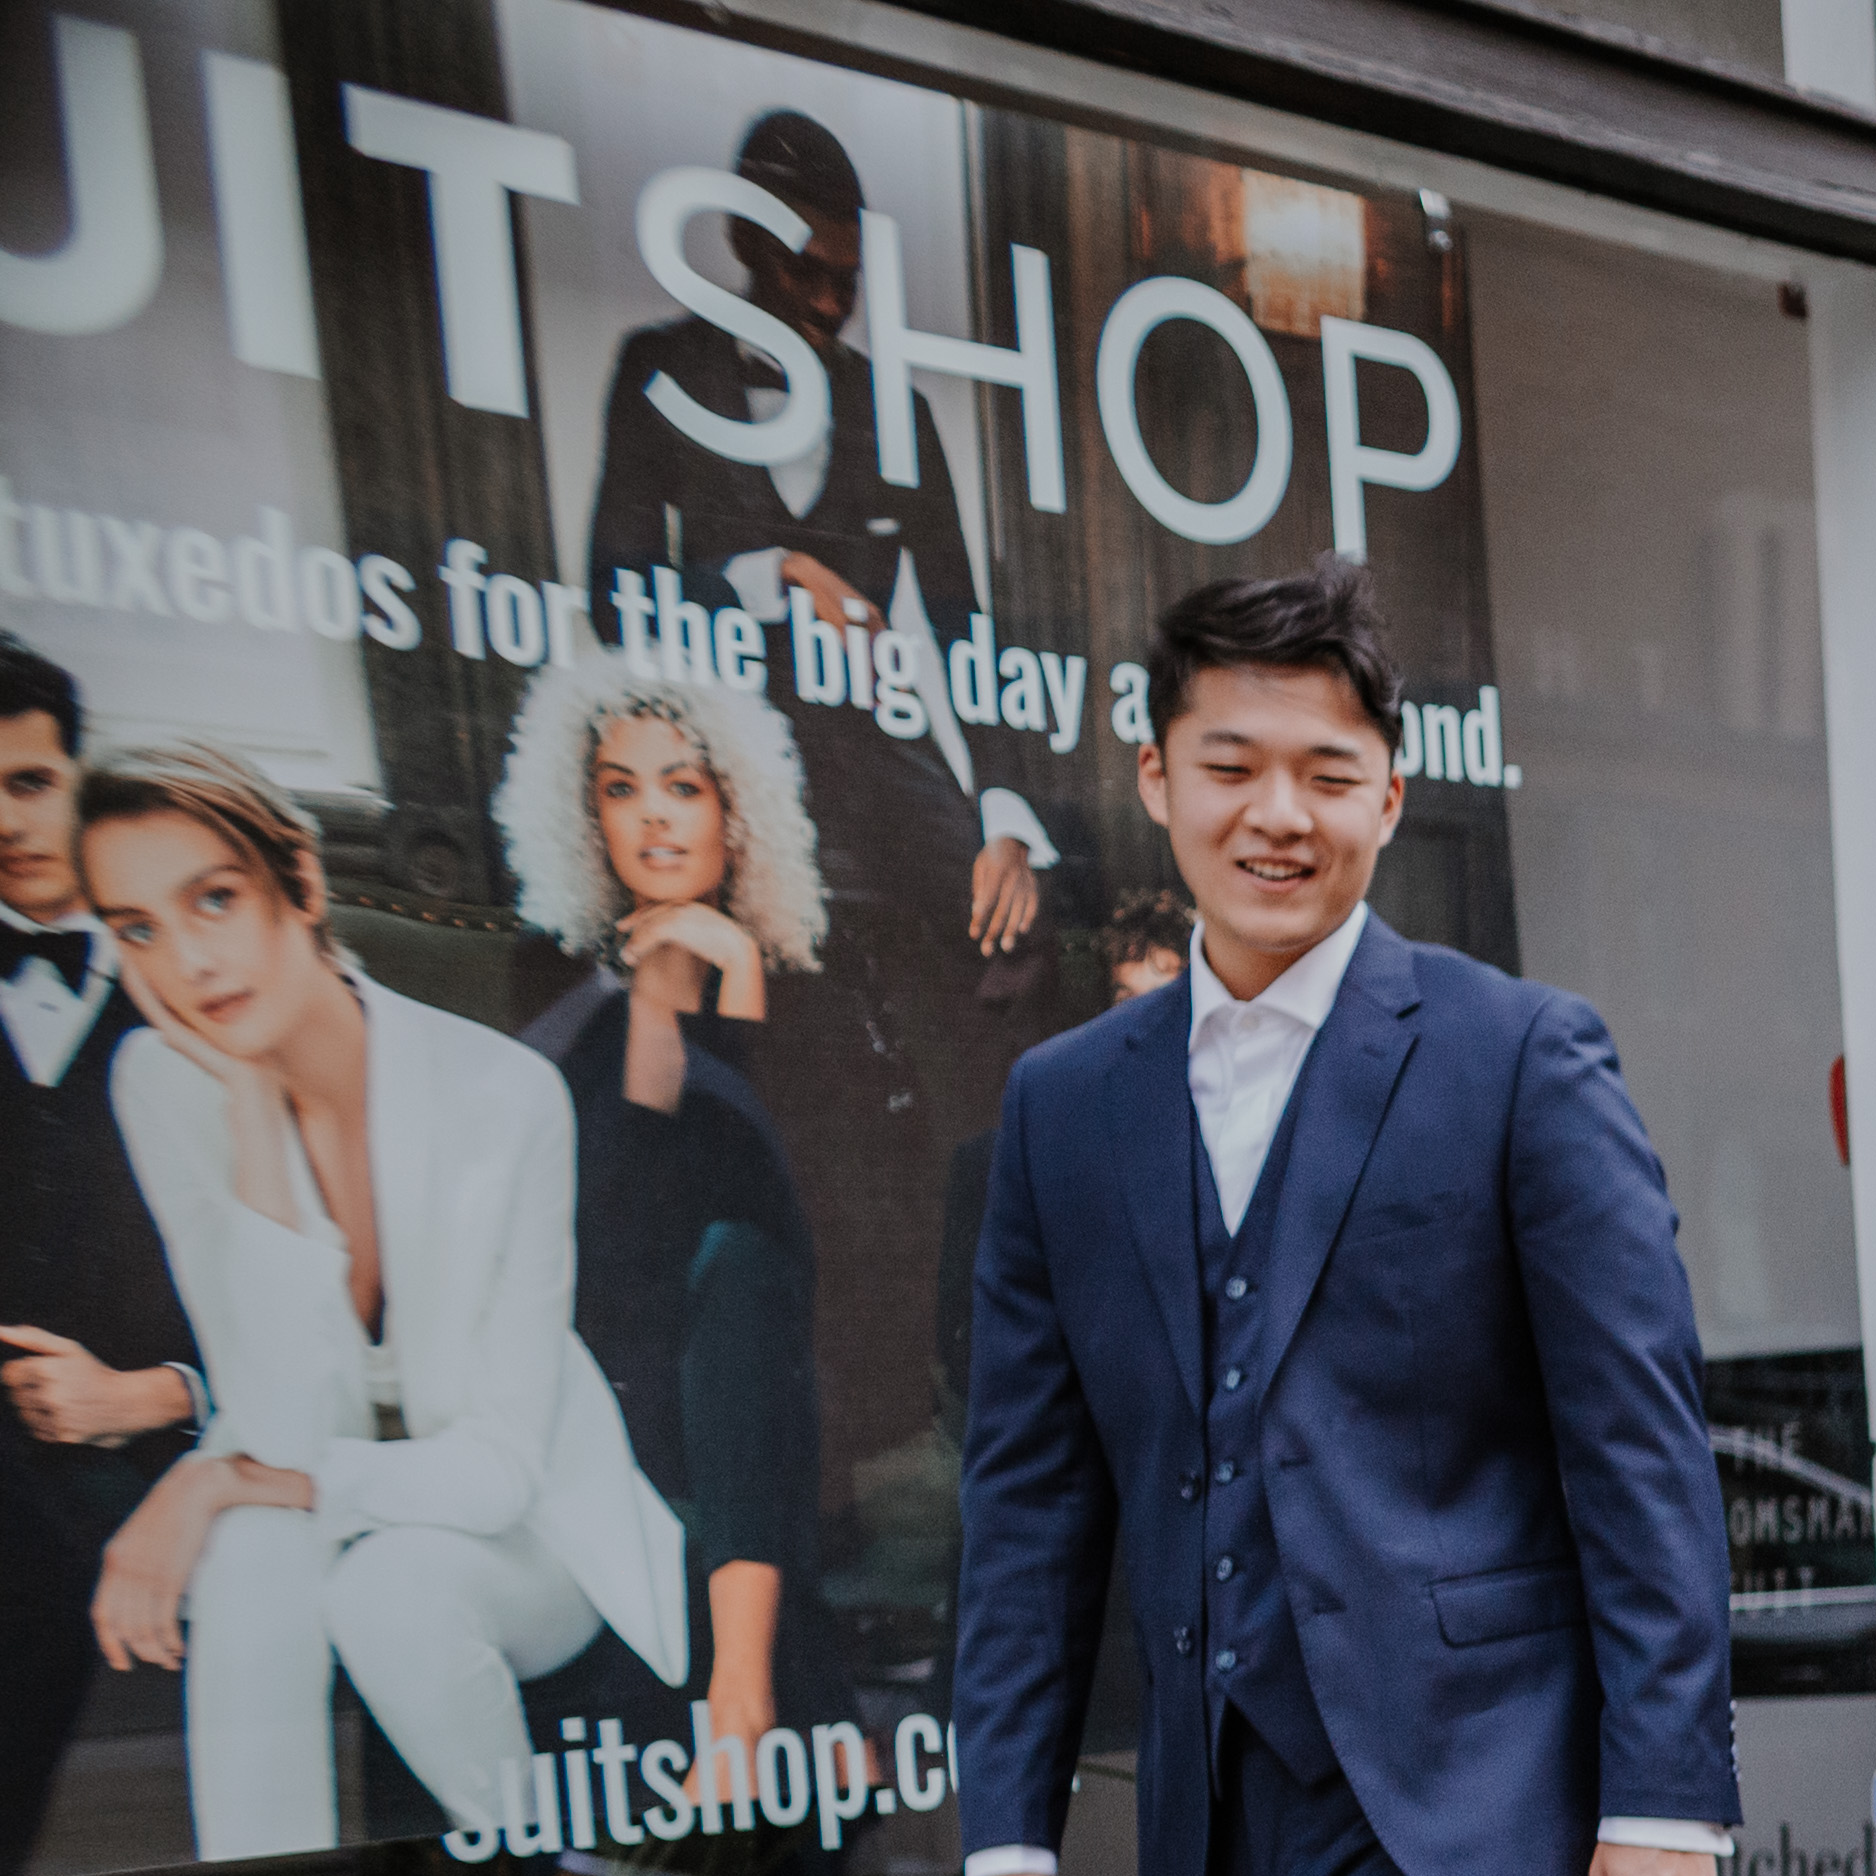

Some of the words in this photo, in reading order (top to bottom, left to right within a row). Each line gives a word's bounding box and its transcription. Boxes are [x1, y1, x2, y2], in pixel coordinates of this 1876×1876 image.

[440, 538, 588, 668] for
[611, 565, 767, 692] the
[789, 586, 928, 740] big
[949, 612, 1088, 754] day
[1398, 685, 1522, 788] ond.
[1728, 1494, 1875, 1546] OMSMA
[440, 1699, 960, 1864] suitshop.c
